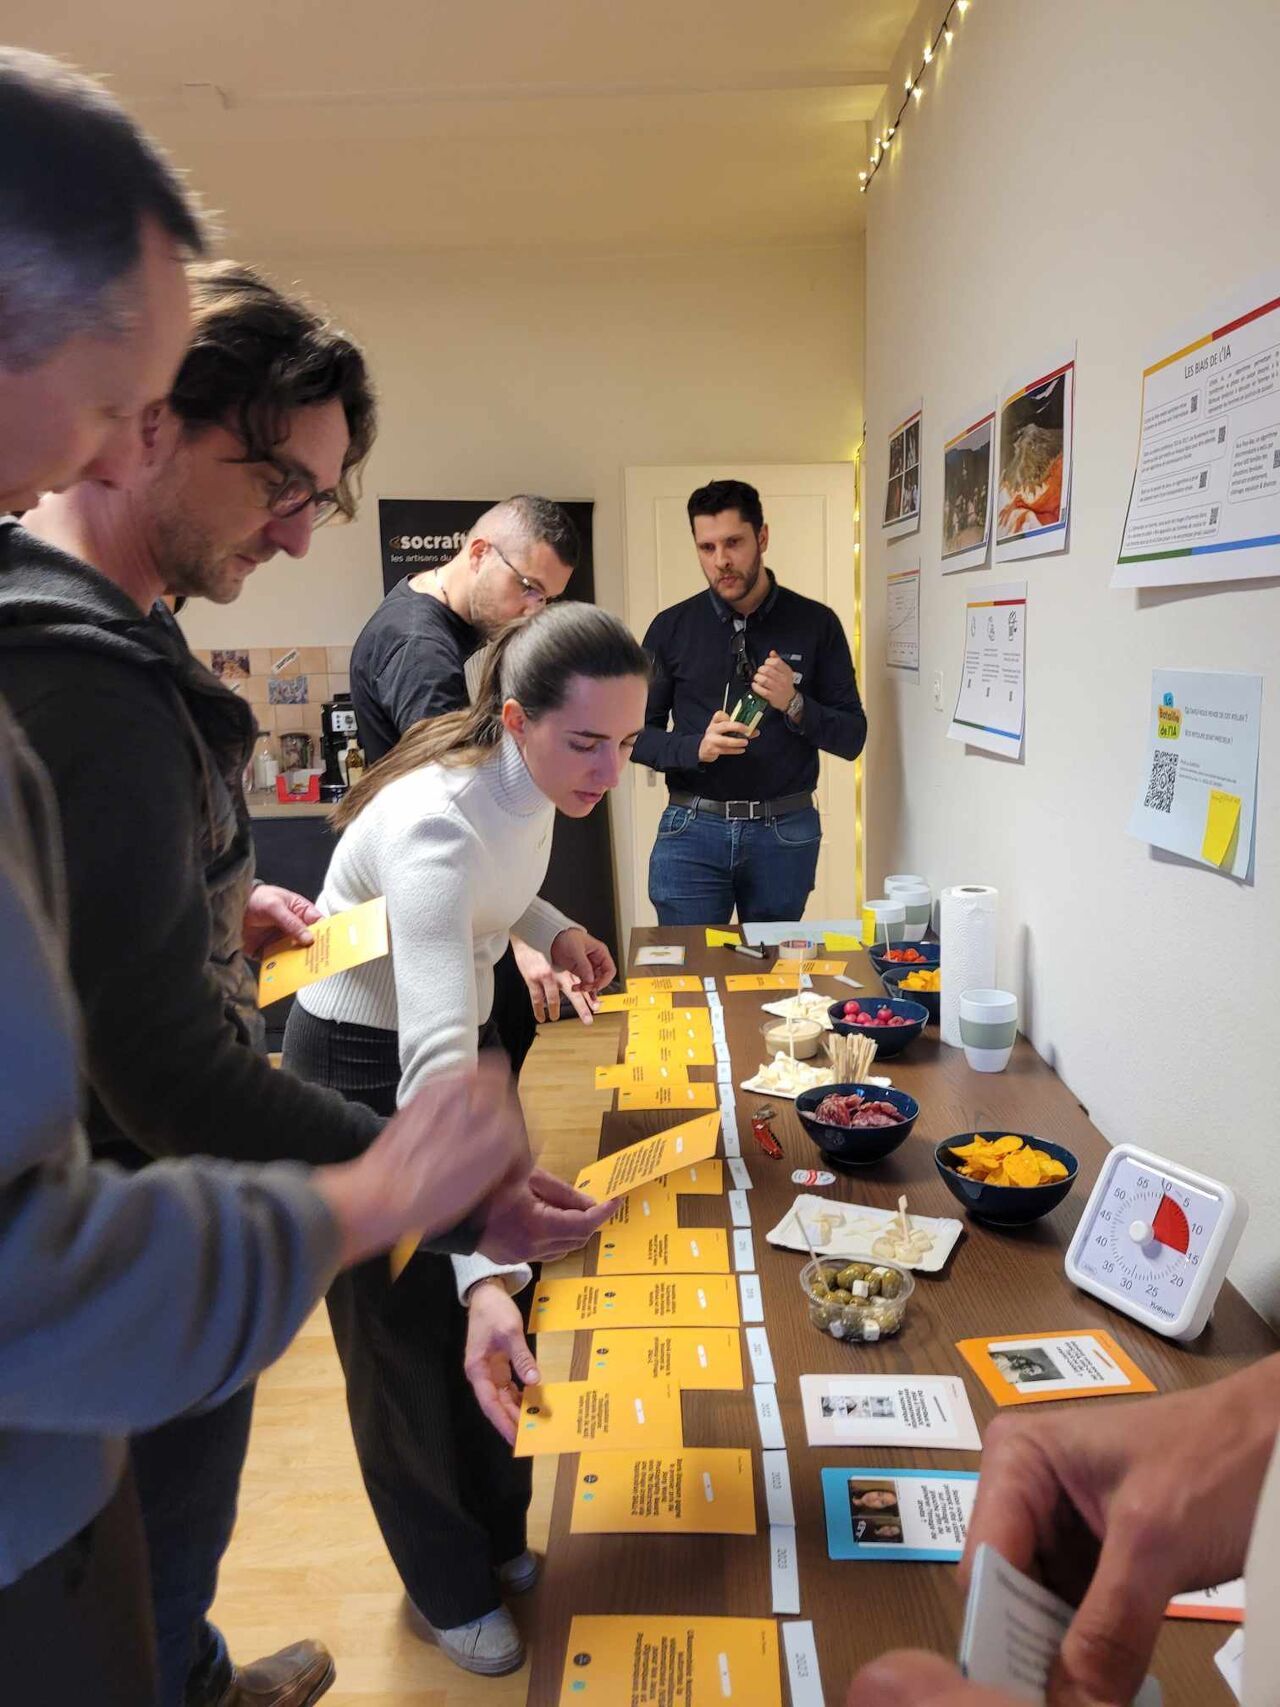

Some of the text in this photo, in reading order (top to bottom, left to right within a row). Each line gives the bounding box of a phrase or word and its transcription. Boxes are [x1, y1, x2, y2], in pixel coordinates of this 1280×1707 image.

[1184, 365, 1195, 379] LES
[1195, 357, 1209, 375] BIAIS
[1210, 353, 1218, 368] DE
[391, 554, 404, 563] les
[405, 554, 439, 563] artisans
[1137, 1177, 1149, 1189] 55
[1114, 1188, 1126, 1200] 50
[1183, 1198, 1191, 1208] 5
[1100, 1209, 1112, 1221] 45
[1191, 1223, 1203, 1235] 10
[1095, 1235, 1108, 1246] 40
[1187, 1253, 1199, 1265] 15
[1102, 1260, 1114, 1273] 35
[1120, 1277, 1133, 1290] 30
[1170, 1274, 1184, 1287] 20
[1145, 1284, 1158, 1298] 25
[776, 1548, 788, 1570] 2023
[794, 1652, 809, 1678] 2023
